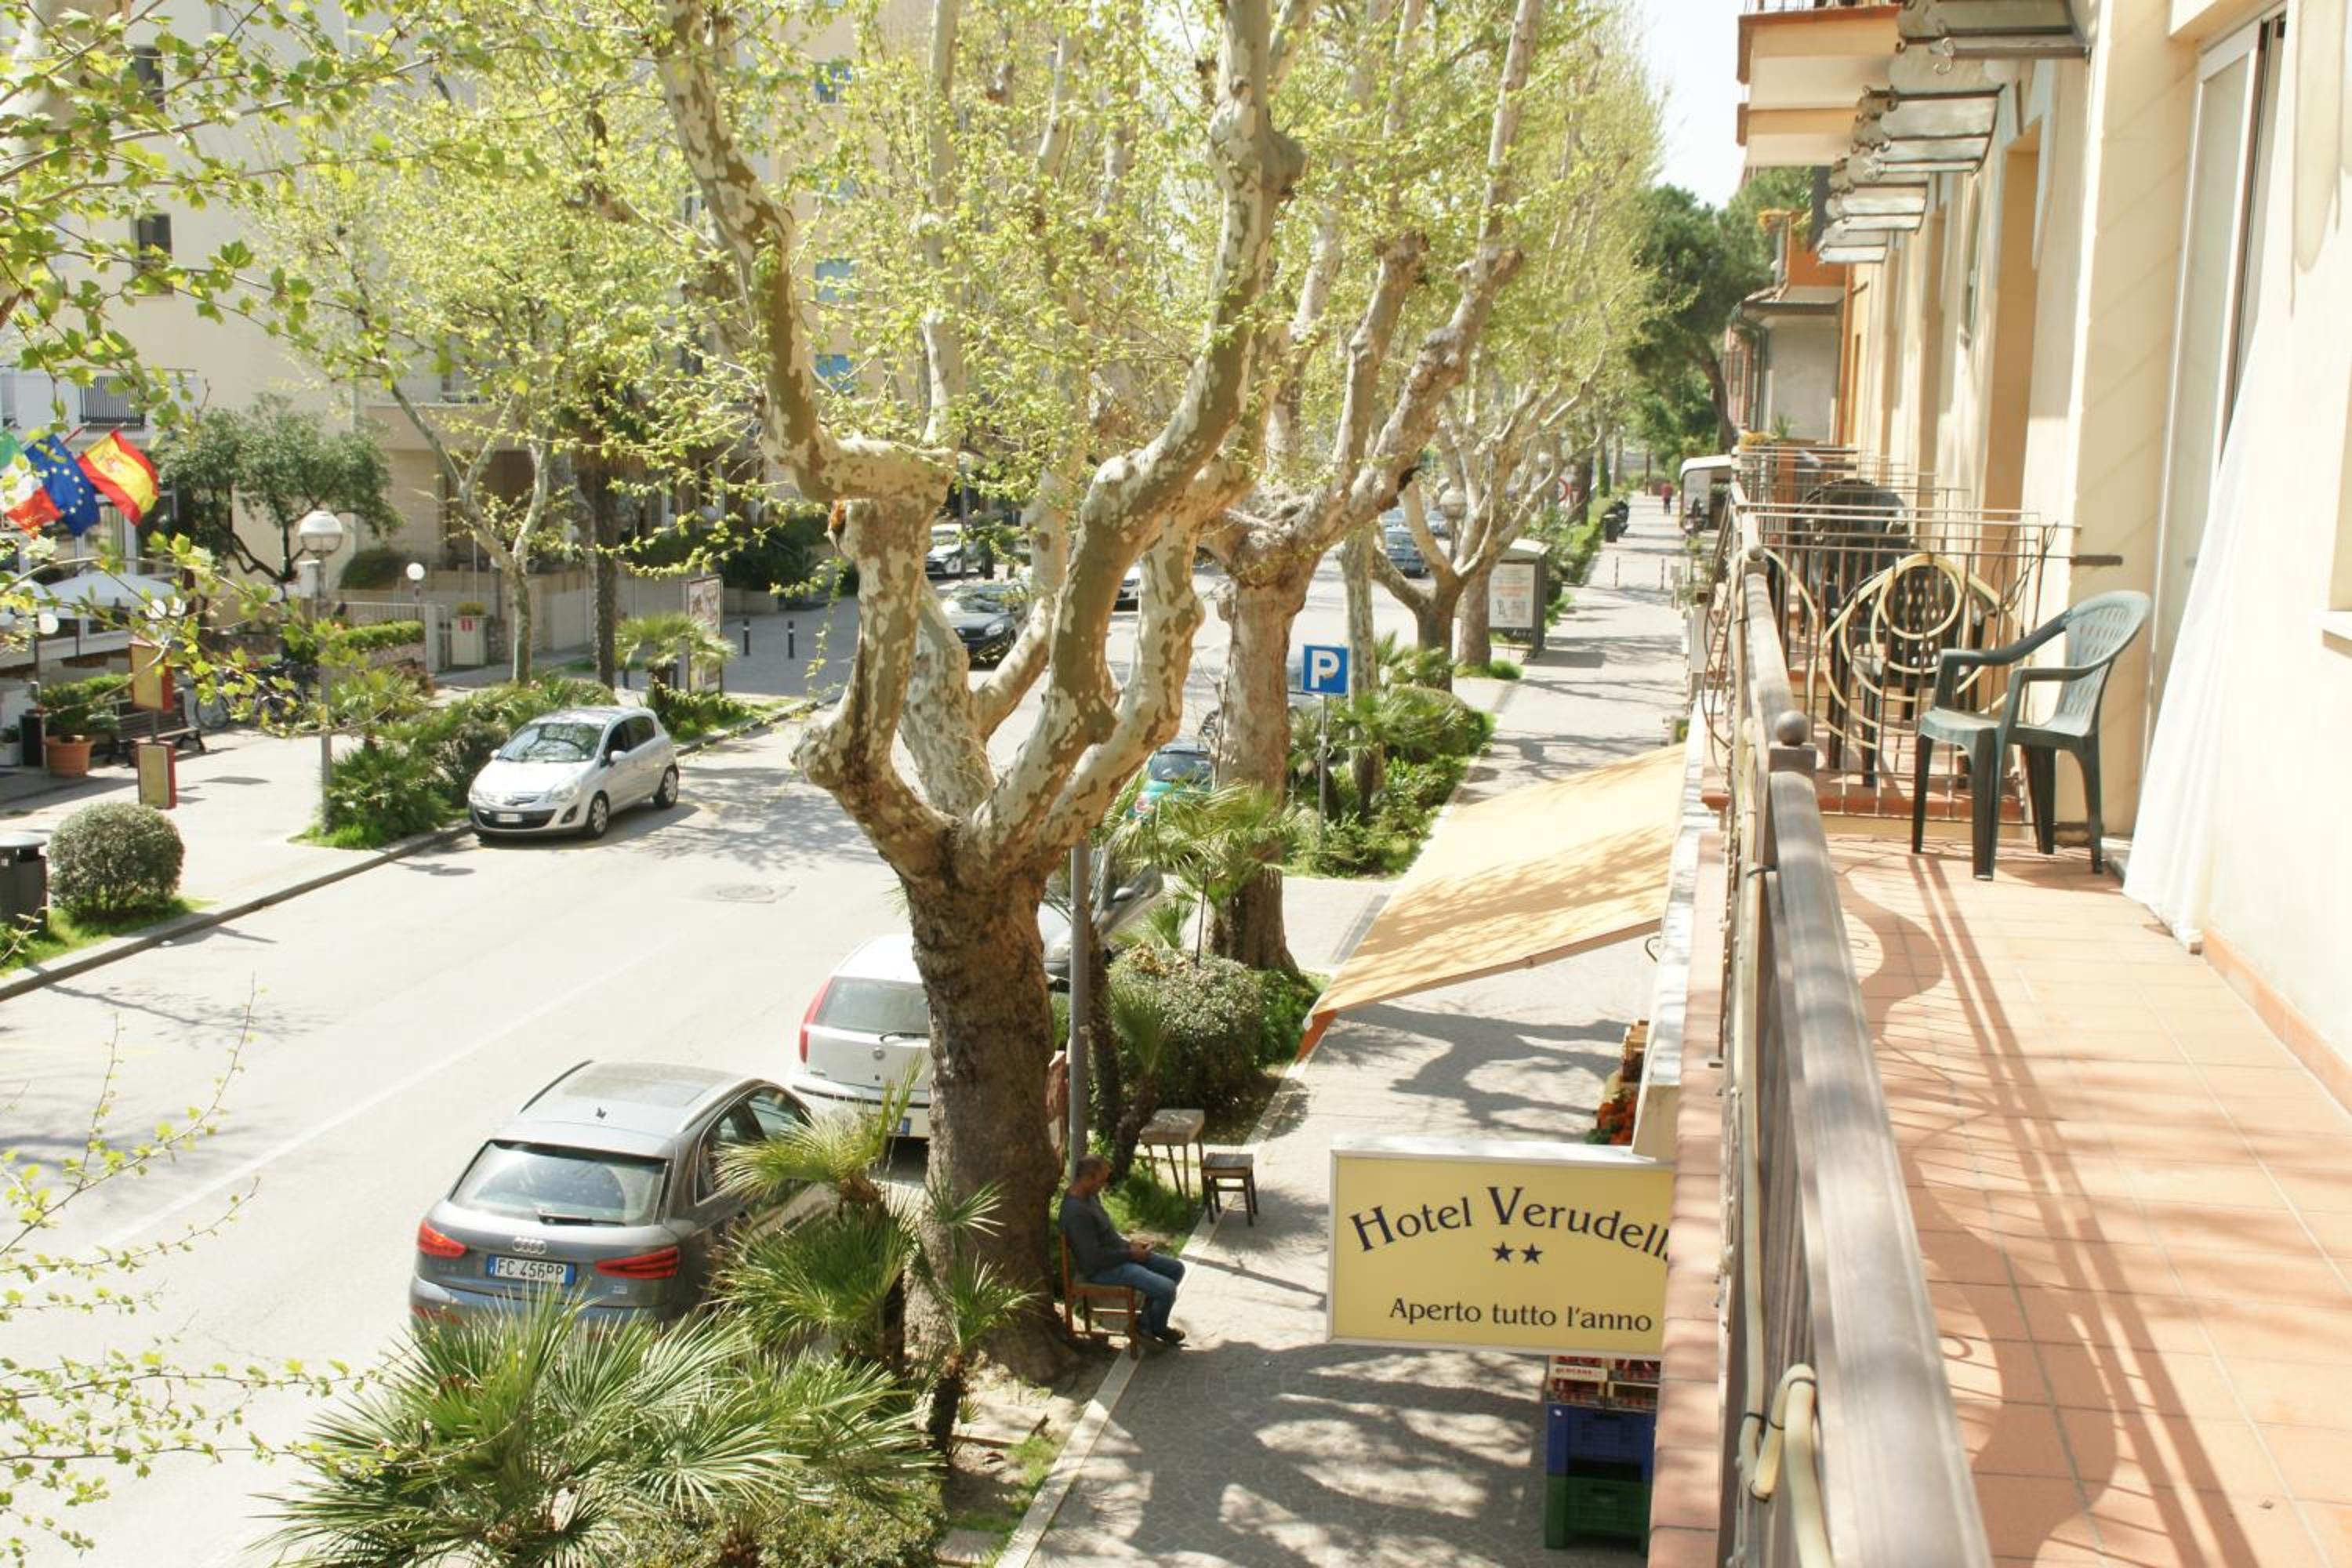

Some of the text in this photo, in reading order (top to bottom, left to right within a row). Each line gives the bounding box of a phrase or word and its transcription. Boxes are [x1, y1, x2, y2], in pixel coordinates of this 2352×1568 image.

[1310, 649, 1340, 689] P
[1348, 1186, 1668, 1262] Hotel Verudell
[1389, 1297, 1652, 1332] Aperto tutto l'anno
